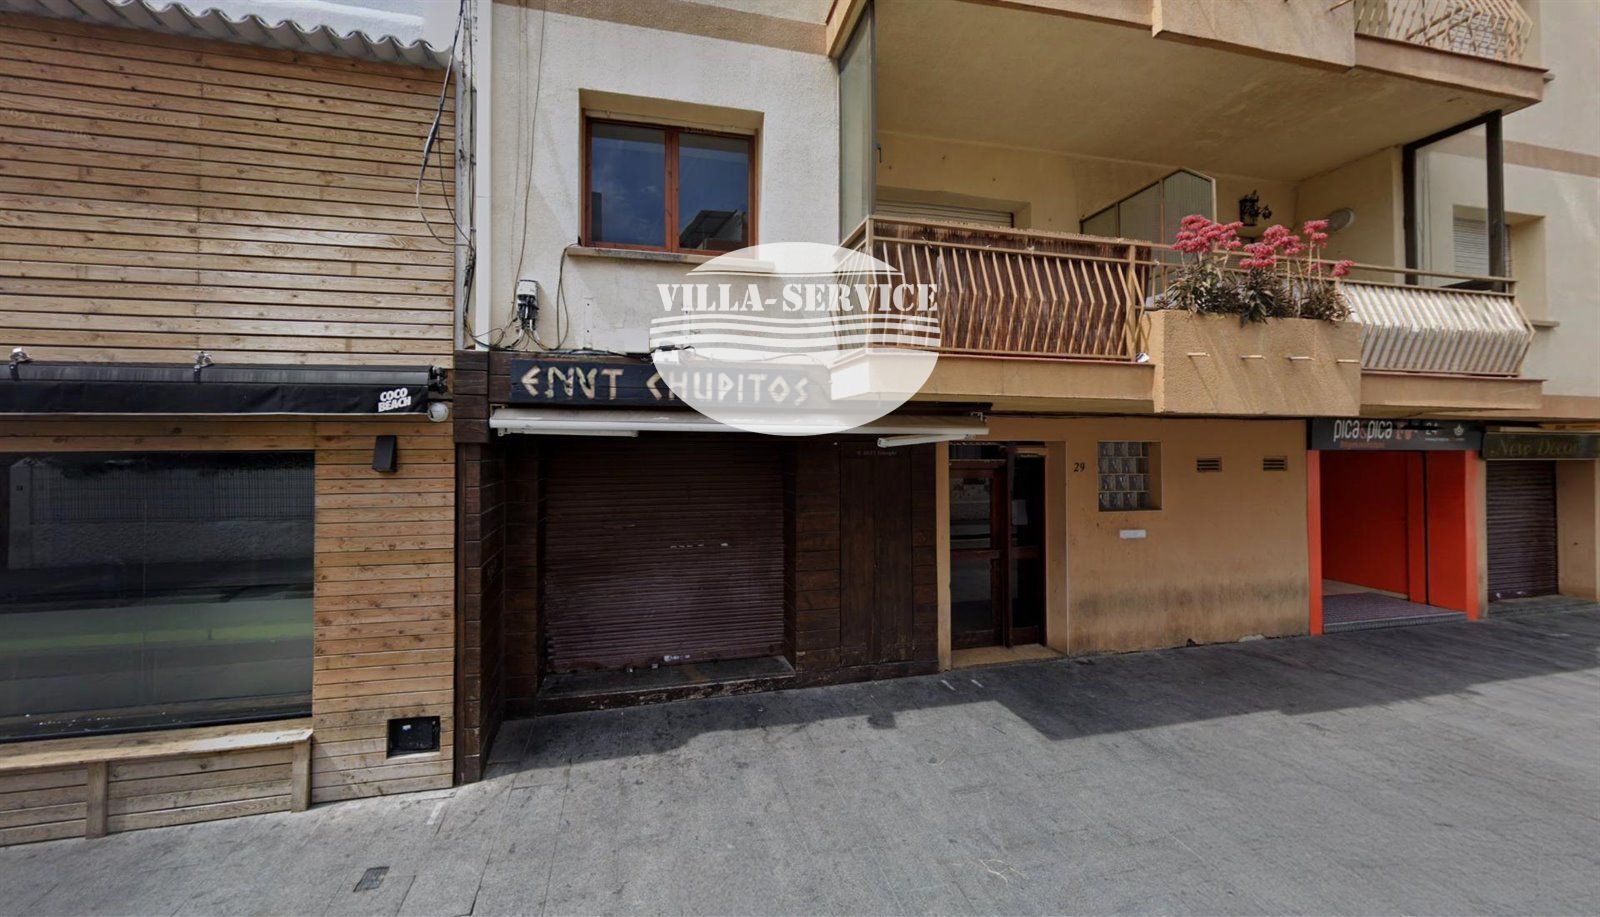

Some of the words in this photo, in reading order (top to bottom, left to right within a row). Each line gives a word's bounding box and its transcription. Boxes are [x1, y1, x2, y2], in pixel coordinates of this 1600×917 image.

[380, 387, 408, 401] COCO
[646, 371, 808, 406] CHUPITOS
[378, 395, 411, 412] BEACH
[1073, 462, 1085, 472] 29
